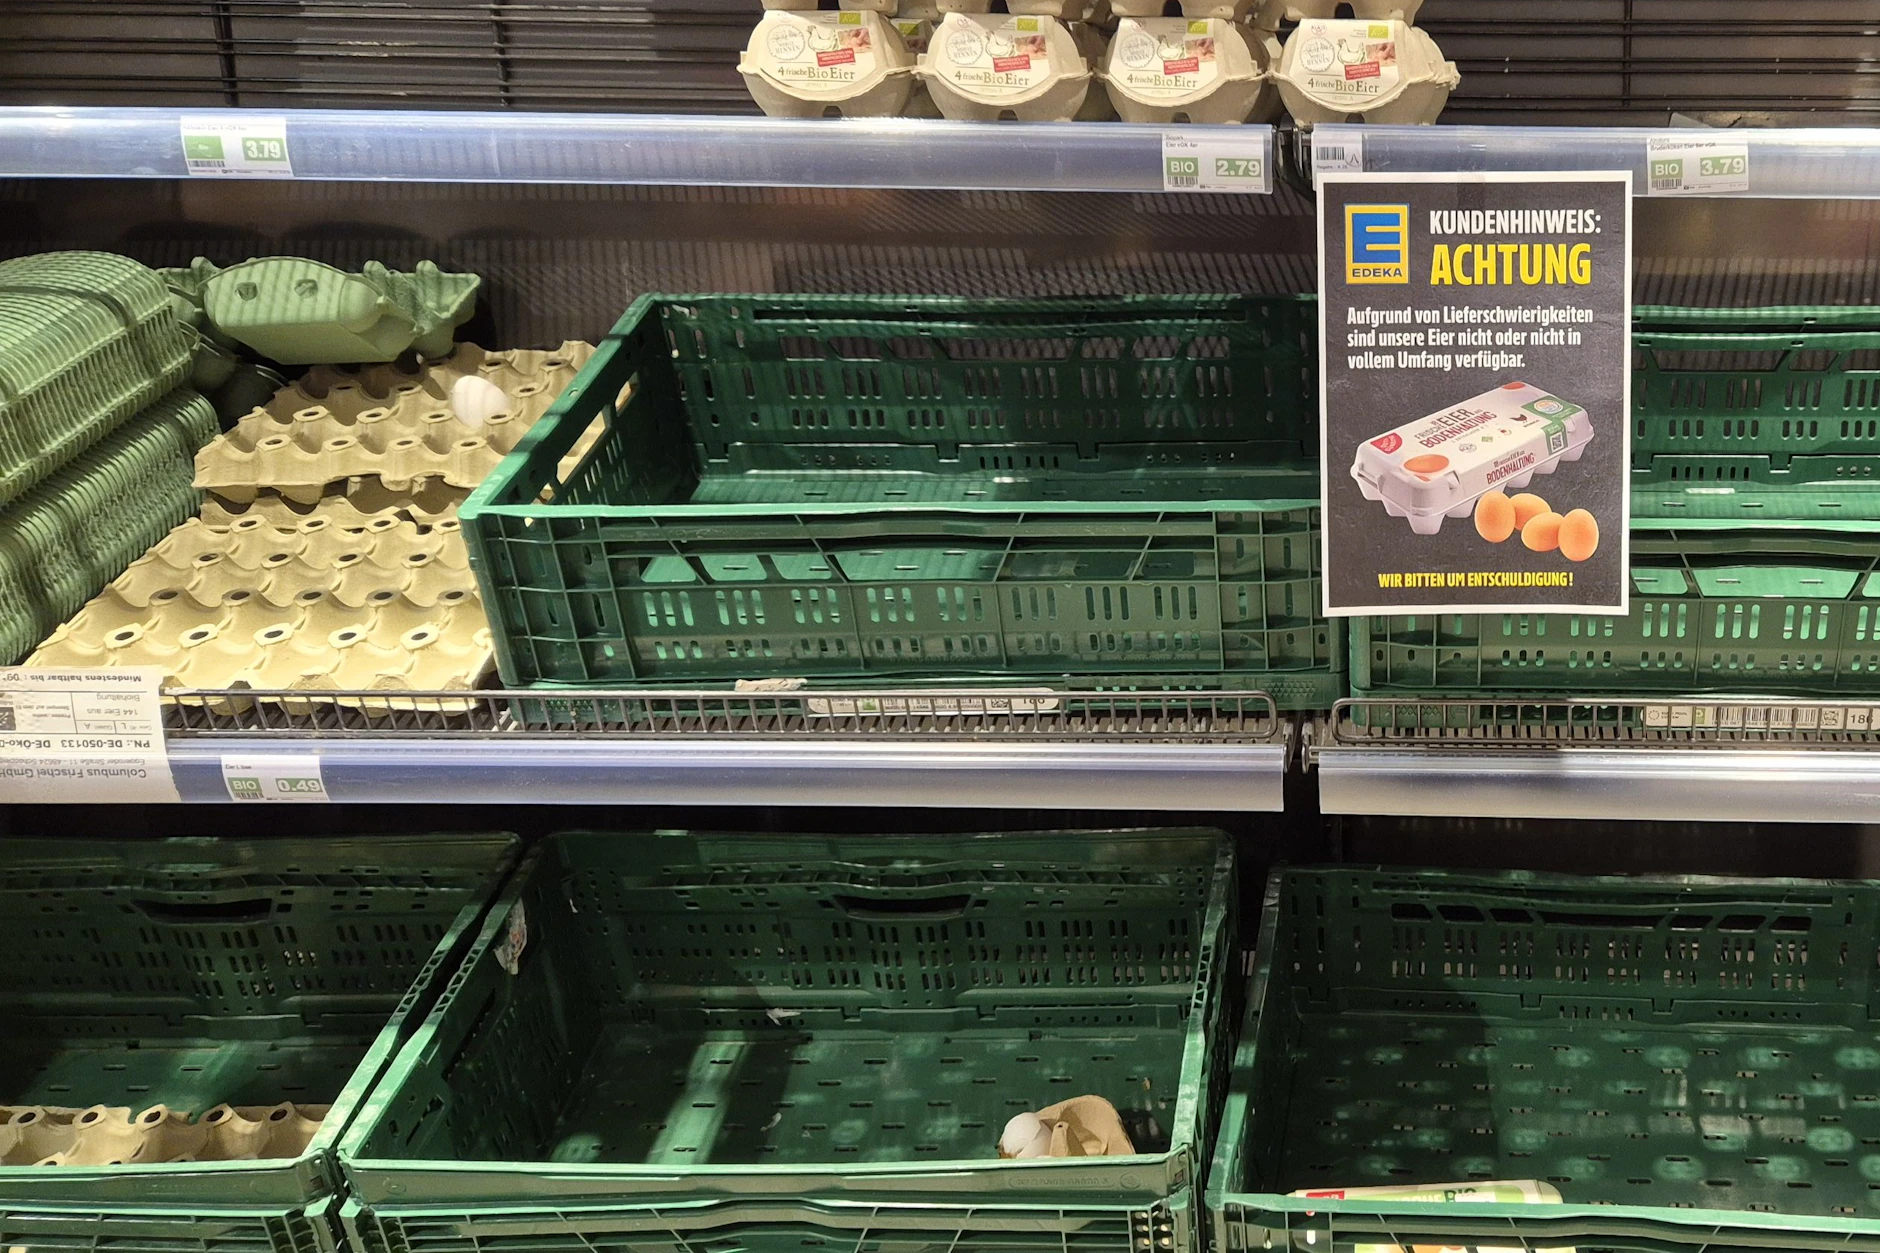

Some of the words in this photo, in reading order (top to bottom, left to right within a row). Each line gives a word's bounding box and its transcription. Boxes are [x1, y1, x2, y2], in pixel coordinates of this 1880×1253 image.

[777, 67, 785, 76] 4
[786, 68, 808, 76] frische
[954, 71, 962, 80] 4
[963, 72, 984, 81] frische
[1126, 74, 1134, 84] 4
[1134, 76, 1154, 84] frische
[1307, 79, 1315, 89] 4
[1315, 81, 1336, 89] frische
[246, 140, 281, 159] 3.79
[1170, 161, 1195, 173] BIO
[1216, 160, 1261, 176] 2.79
[1655, 163, 1679, 176] BIO
[1701, 158, 1745, 175] 3.79
[1430, 209, 1601, 235] KUNDENHINWEIS:
[1430, 243, 1591, 285] ACHTUNG
[1352, 268, 1403, 278] EDEKA
[1347, 307, 1411, 327] Aufgrund
[1415, 310, 1440, 324] von
[1443, 306, 1593, 326] Lieferschwierigkeiten
[1347, 329, 1375, 347] sind
[1379, 332, 1424, 347] unsere
[1428, 329, 1455, 346] Eier
[1458, 328, 1492, 346] nicht
[1495, 328, 1527, 346] oder
[1530, 328, 1565, 346] nicht
[1568, 328, 1581, 346] in
[1348, 352, 1394, 369] vollem
[1398, 351, 1452, 372] Umfang
[1455, 350, 1526, 371] verfügbar.
[1438, 408, 1476, 428] EIER
[1419, 411, 1498, 449] BODENHALTUNG
[1486, 452, 1535, 485] BODENHALTUNG
[1378, 573, 1403, 588] WIR
[1404, 573, 1445, 587] BITTEN
[1447, 573, 1465, 587] UM
[1467, 572, 1573, 587] ENTSCHULDIGUNG!
[29, 674, 44, 682] bis
[47, 674, 82, 682] haltbar
[96, 692, 140, 701] Biohaltung
[104, 708, 121, 716] Eier
[122, 708, 138, 716] 144
[60, 739, 123, 748] DE-050133
[36, 768, 83, 778] Frischei
[86, 768, 147, 778] Columbus
[233, 780, 257, 790] BIO
[278, 779, 321, 792] 0.49
